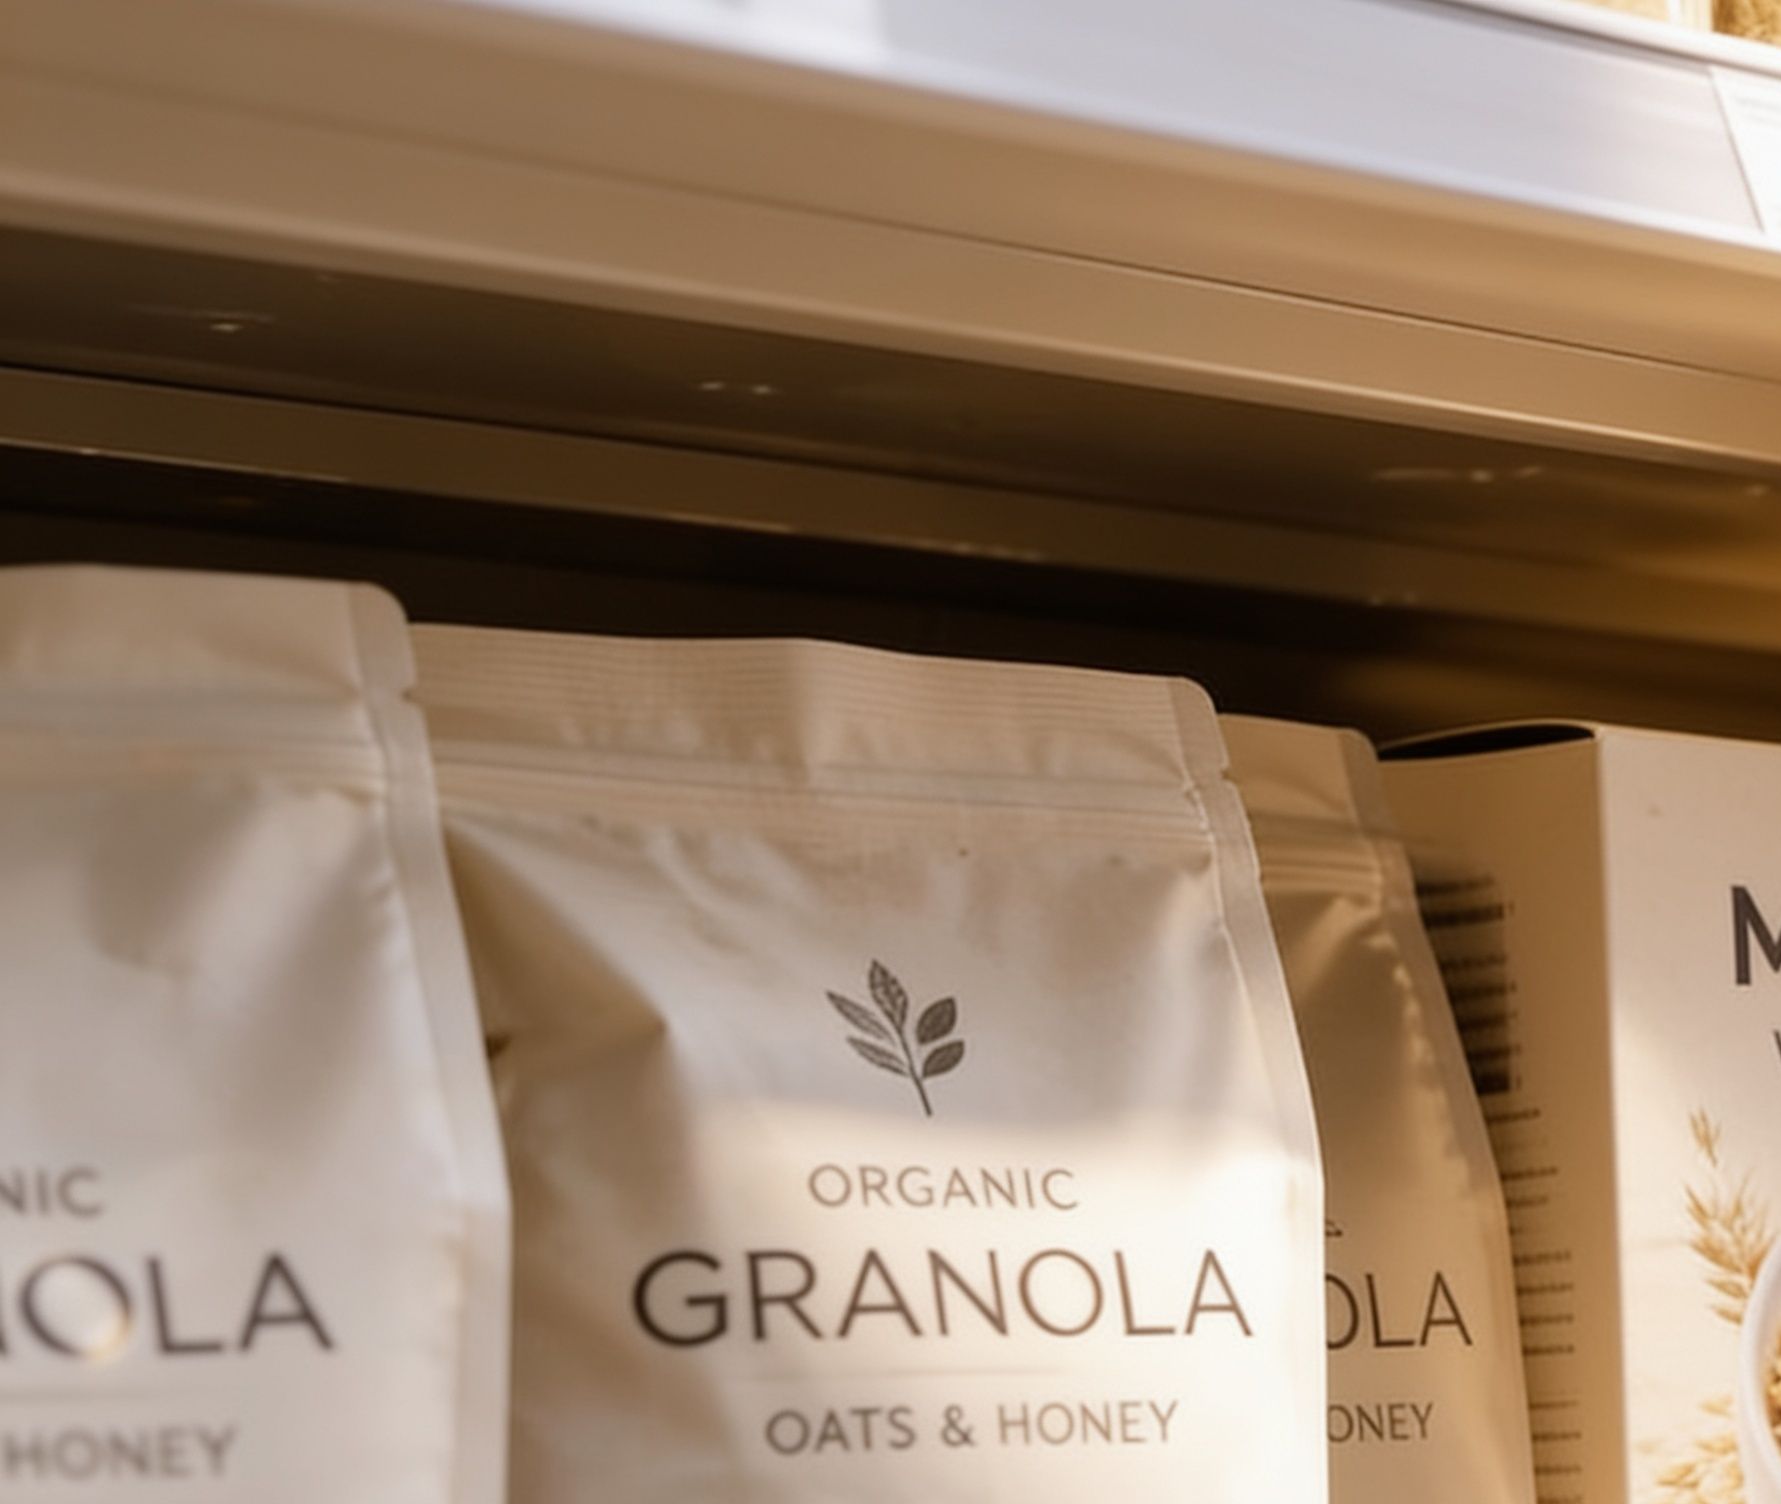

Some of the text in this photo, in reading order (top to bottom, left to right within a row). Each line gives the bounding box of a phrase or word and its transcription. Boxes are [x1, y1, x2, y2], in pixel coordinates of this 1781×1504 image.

[809, 1164, 1078, 1210] ORGANIC
[0, 1250, 335, 1360] OLA
[632, 1247, 1253, 1347] GRANOLA
[765, 1401, 1179, 1455] OATS & HONEY
